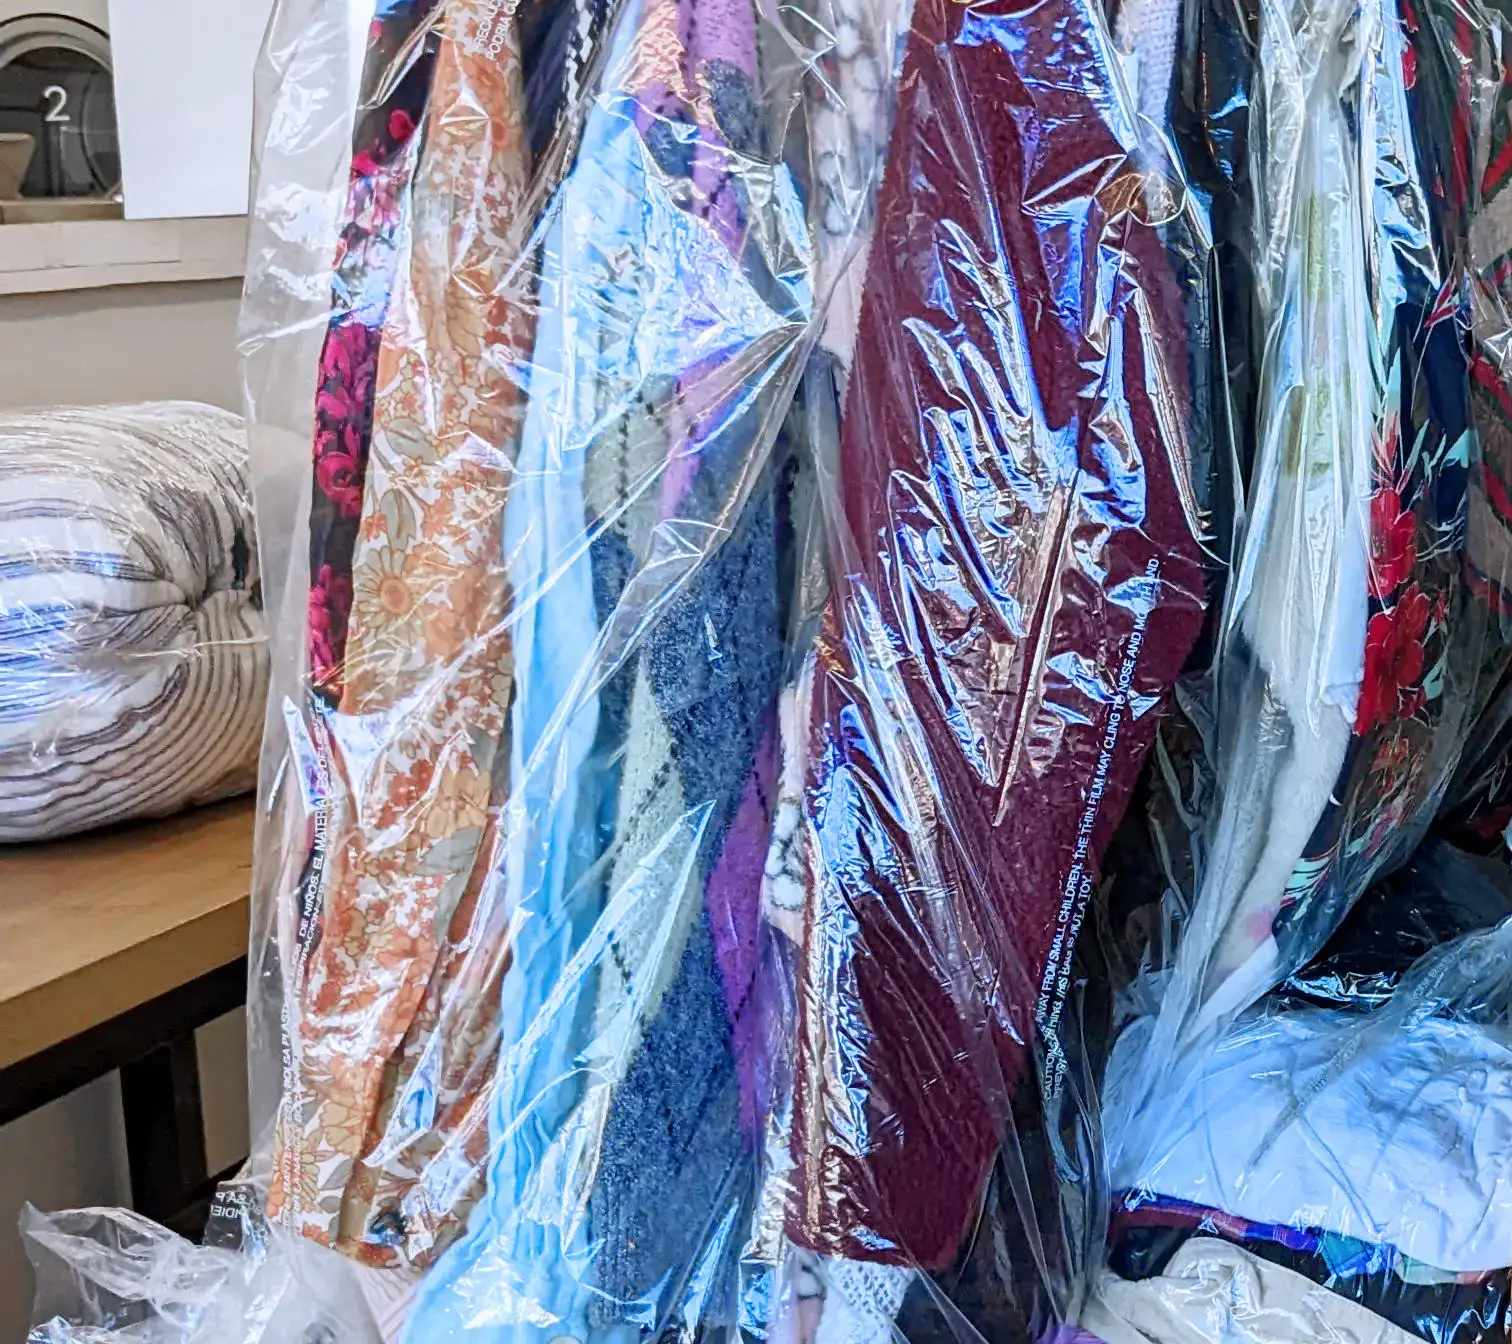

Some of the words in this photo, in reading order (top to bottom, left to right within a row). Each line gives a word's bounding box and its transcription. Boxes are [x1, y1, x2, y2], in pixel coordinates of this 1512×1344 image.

[484, 12, 512, 62] PODRIA
[43, 84, 71, 122] 2
[1132, 584, 1154, 631] MOTH
[1124, 630, 1142, 658] AND
[1116, 658, 1136, 693] NOSE
[1111, 694, 1126, 711] TO
[1102, 711, 1121, 749] CLING
[1095, 750, 1112, 776] MAY
[1086, 777, 1104, 806] FILM
[1079, 806, 1096, 835] THIN
[1071, 835, 1089, 860] THE
[1057, 861, 1083, 923] CHILDREN.
[1076, 900, 1086, 910] A
[1048, 925, 1066, 961] SMALL
[282, 1124, 293, 1193] MANTEN
[297, 917, 308, 937] DE
[312, 853, 323, 869] EL
[1034, 991, 1050, 1023] AWAY
